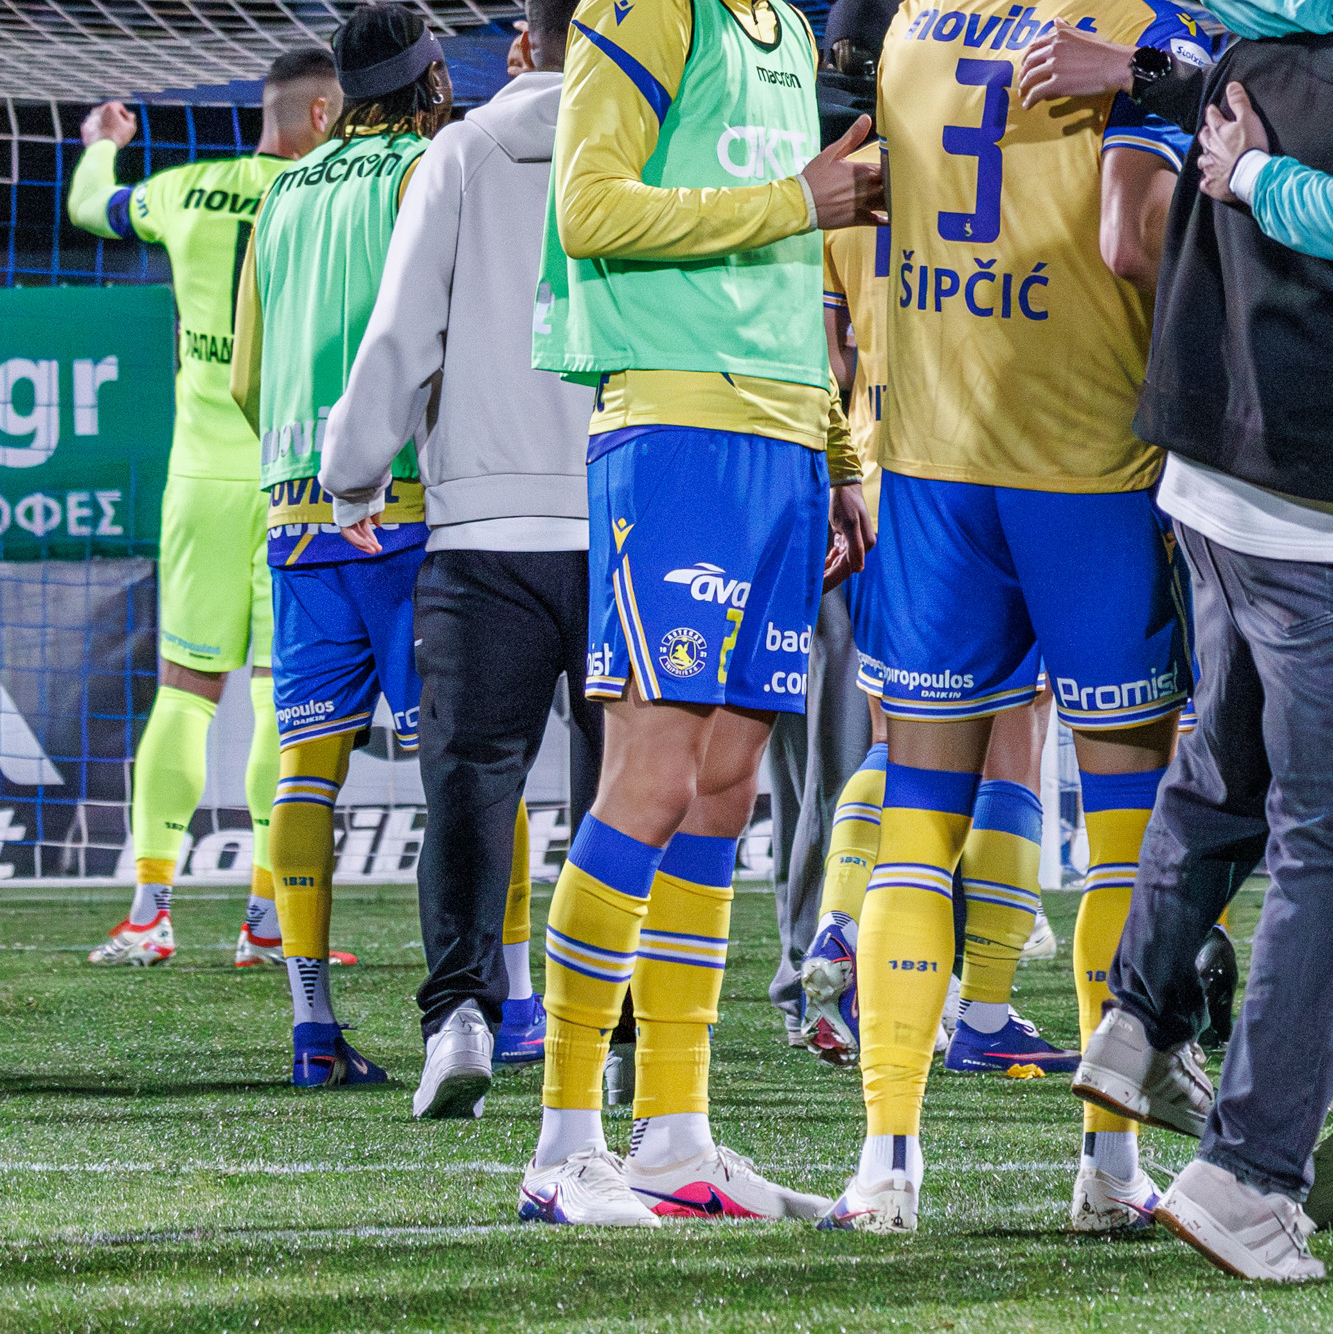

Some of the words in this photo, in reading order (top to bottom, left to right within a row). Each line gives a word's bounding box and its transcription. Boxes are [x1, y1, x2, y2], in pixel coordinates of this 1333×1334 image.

[904, 4, 1098, 50] novib
[757, 66, 803, 89] macron
[936, 58, 1014, 243] 3
[279, 152, 404, 193] macron
[899, 249, 1050, 321] ŠIPČIĆ
[920, 689, 962, 700] DAIKIN
